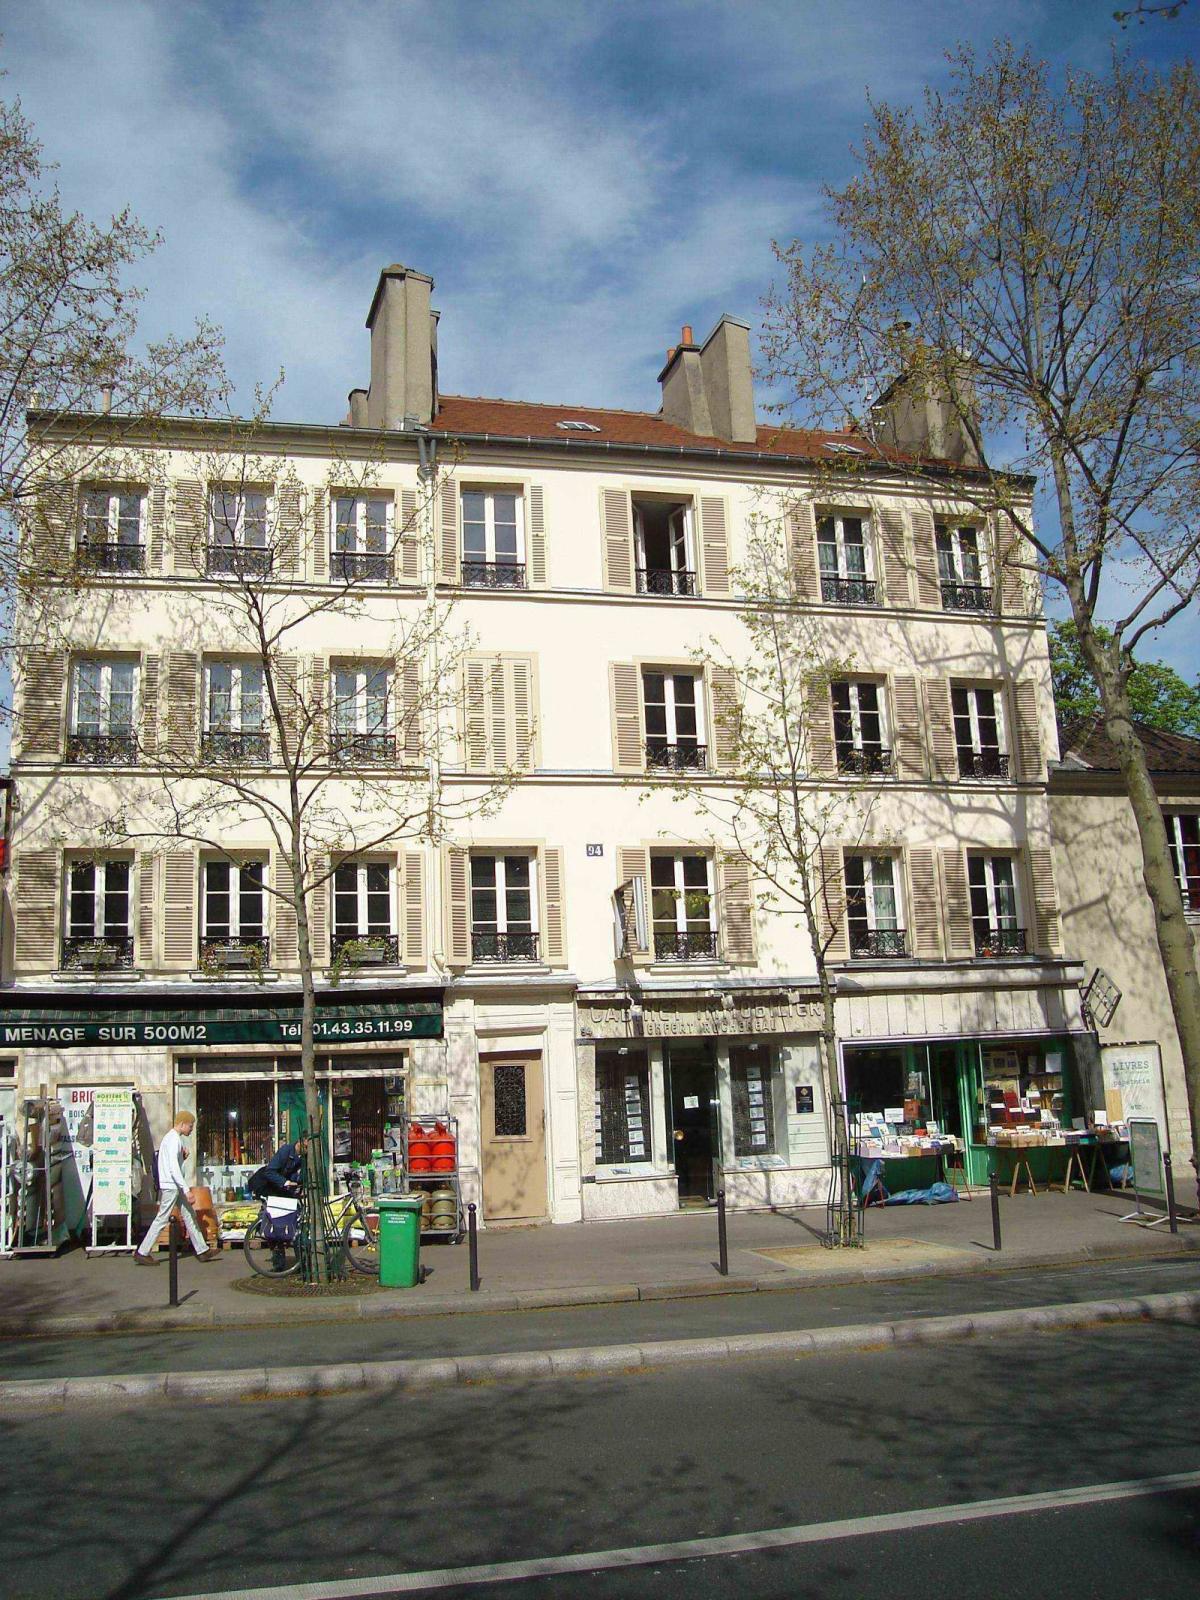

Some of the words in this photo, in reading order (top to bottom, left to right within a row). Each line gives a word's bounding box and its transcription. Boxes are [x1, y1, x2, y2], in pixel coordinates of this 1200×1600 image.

[587, 845, 602, 856] 94
[590, 1003, 683, 1024] CABNET
[5, 1027, 86, 1042] MENAGE
[98, 1027, 137, 1040] SUR
[143, 1025, 207, 1040] 500M2
[312, 1019, 413, 1035] 01.43.35.11.99
[1112, 1061, 1150, 1071] LIVRES
